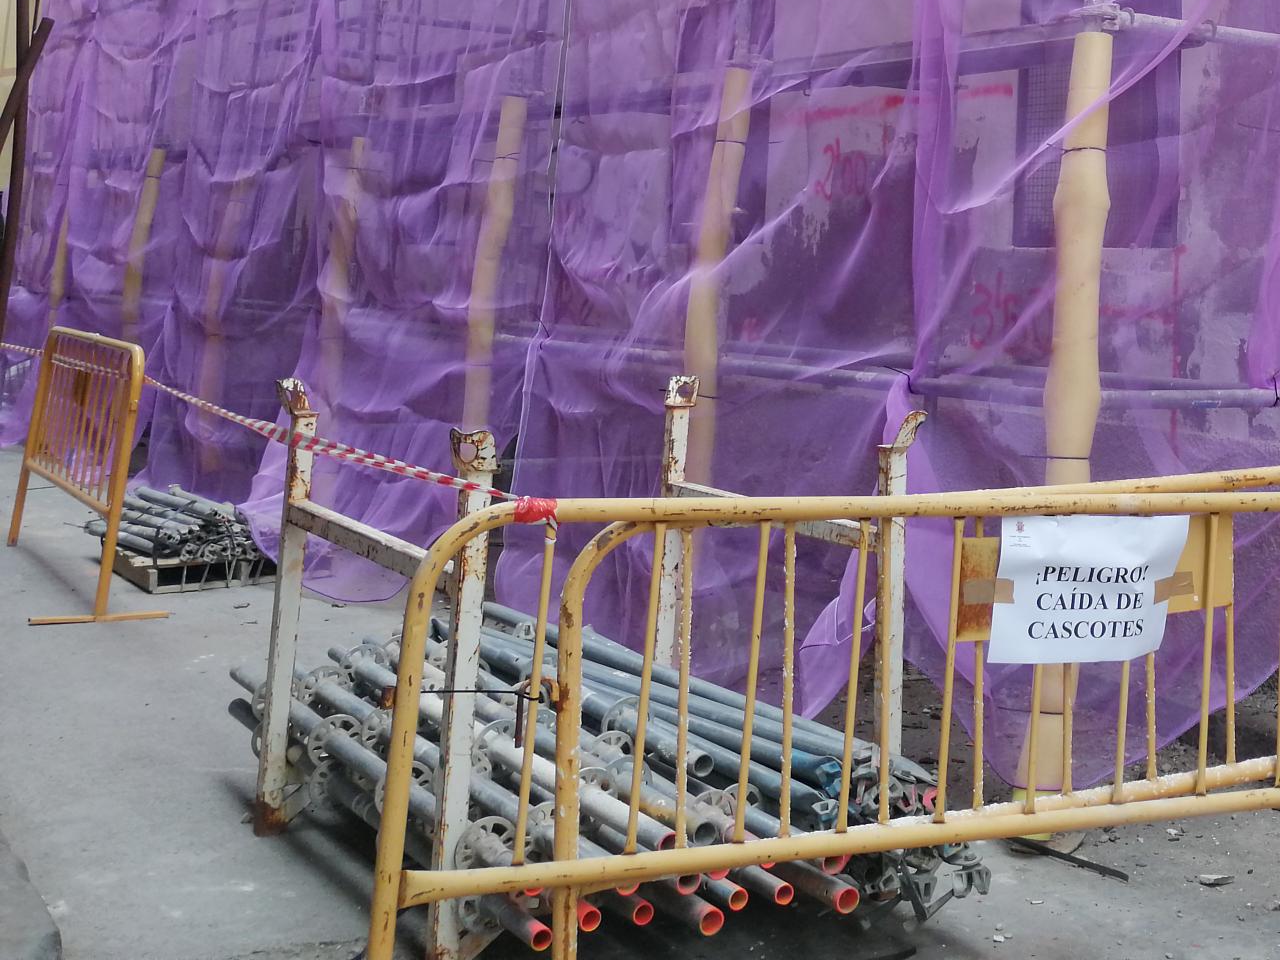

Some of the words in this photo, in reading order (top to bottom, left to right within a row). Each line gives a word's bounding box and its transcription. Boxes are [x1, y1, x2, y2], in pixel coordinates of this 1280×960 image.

[1036, 565, 1149, 585] ¡PELIGRO!
[1037, 587, 1108, 611] CAÍDA
[1117, 592, 1144, 610] DE
[1028, 618, 1144, 640] CASCOTES
